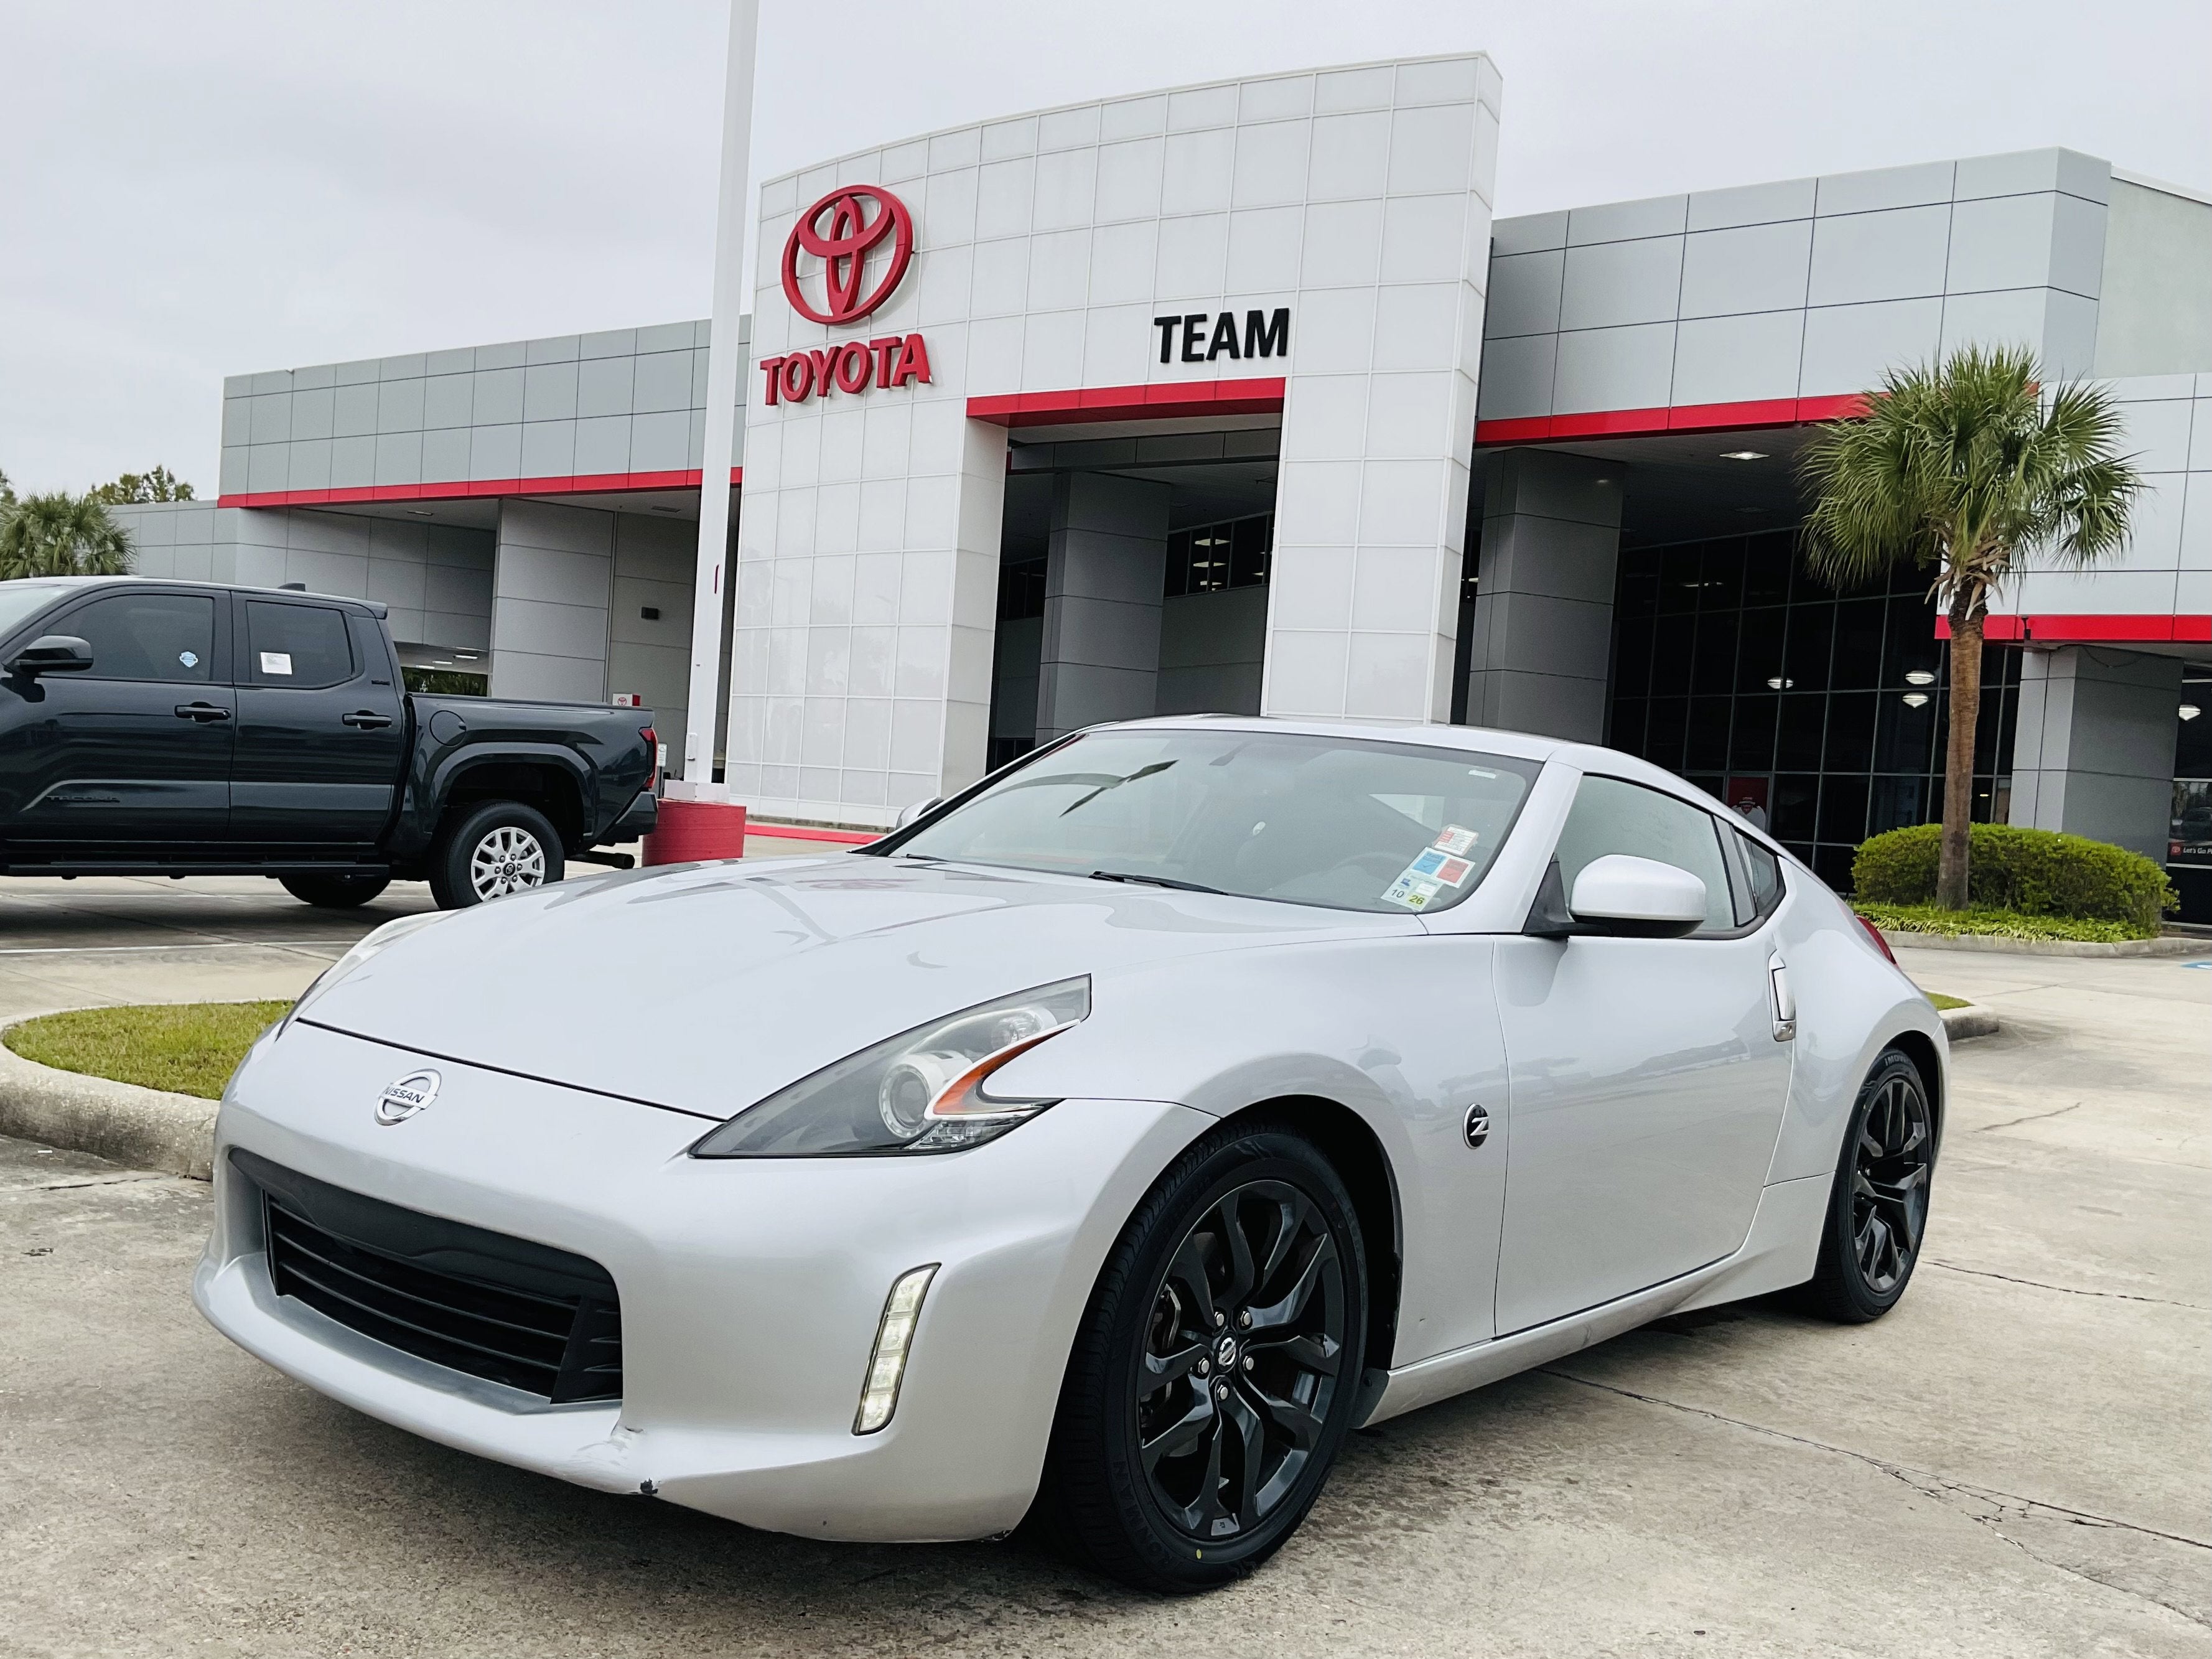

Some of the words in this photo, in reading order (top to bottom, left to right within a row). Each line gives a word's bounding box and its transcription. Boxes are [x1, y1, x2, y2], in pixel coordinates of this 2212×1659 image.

[1154, 307, 1289, 363] TEAM
[760, 334, 932, 406] TOYOTA
[1391, 889, 1405, 898] 10
[1409, 895, 1425, 905] 26
[383, 1086, 426, 1103] NISSAN
